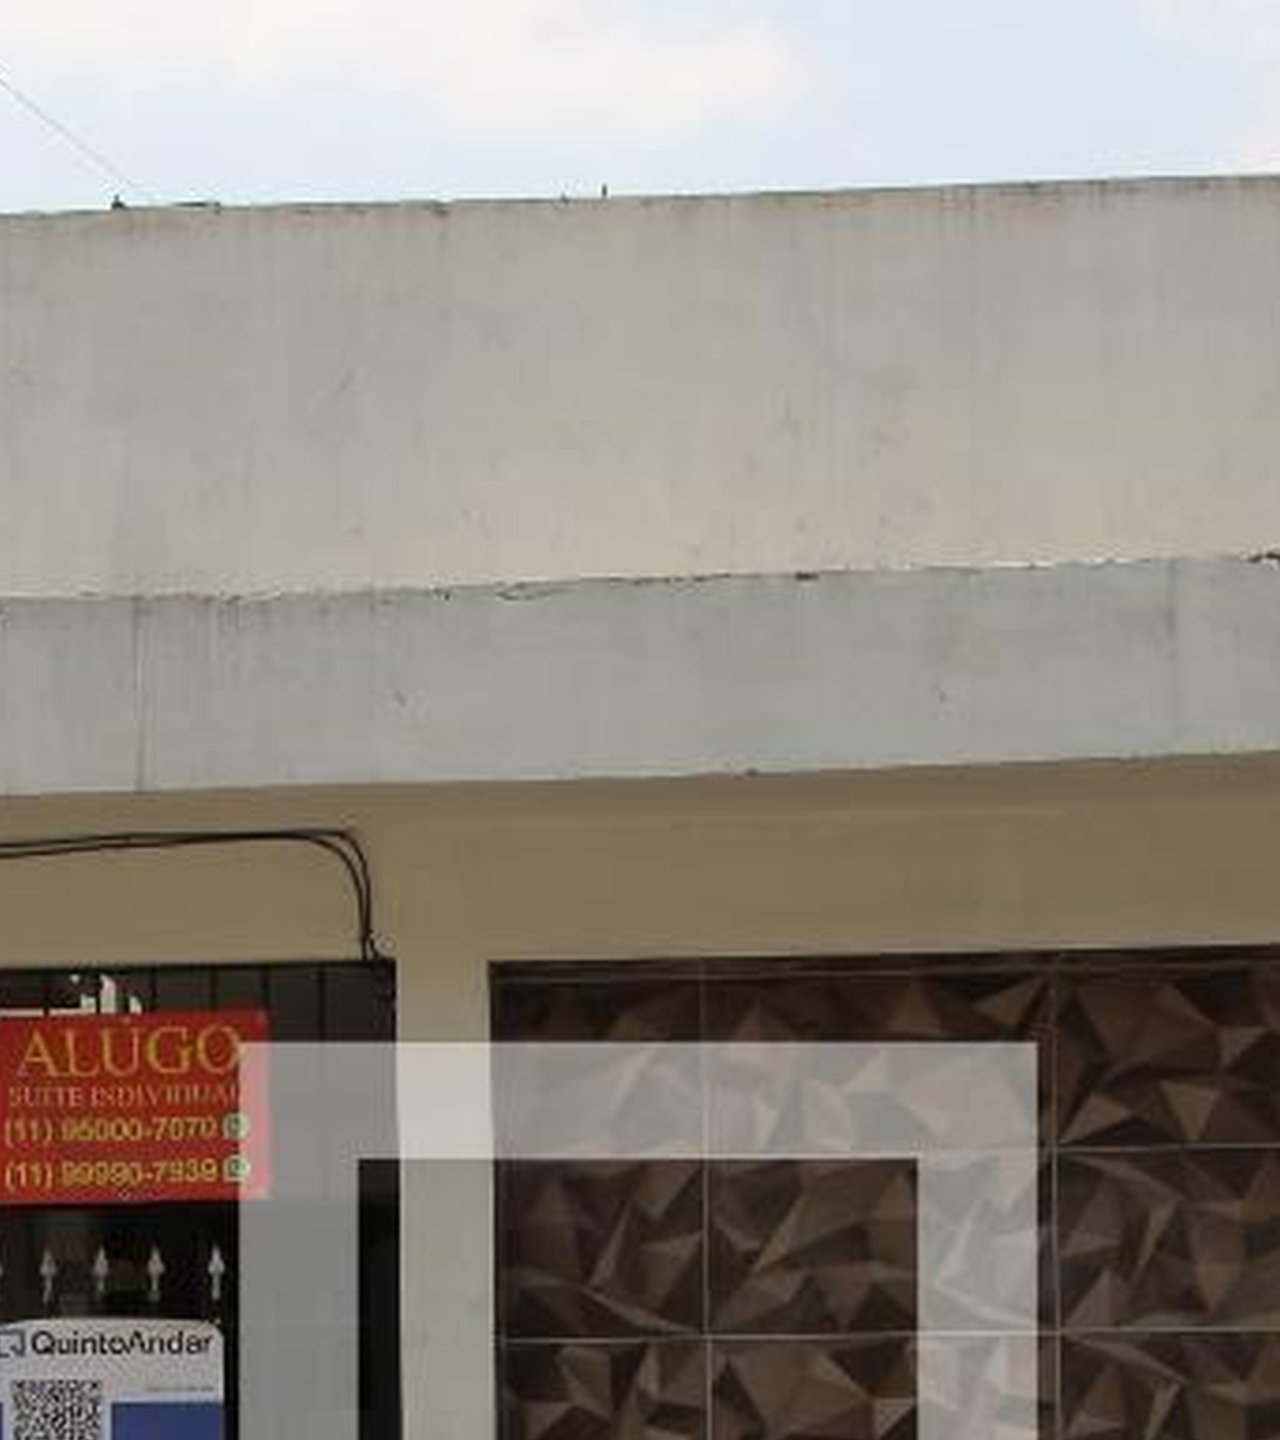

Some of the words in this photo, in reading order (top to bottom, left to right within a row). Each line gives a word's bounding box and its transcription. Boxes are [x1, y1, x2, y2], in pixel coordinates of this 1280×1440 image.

[20, 1024, 242, 1078] ALUGO
[8, 1085, 83, 1108] SUITE
[5, 1117, 53, 1148] (11)
[5, 1160, 53, 1191] (11)
[31, 1330, 214, 1356] QuintoAndar
